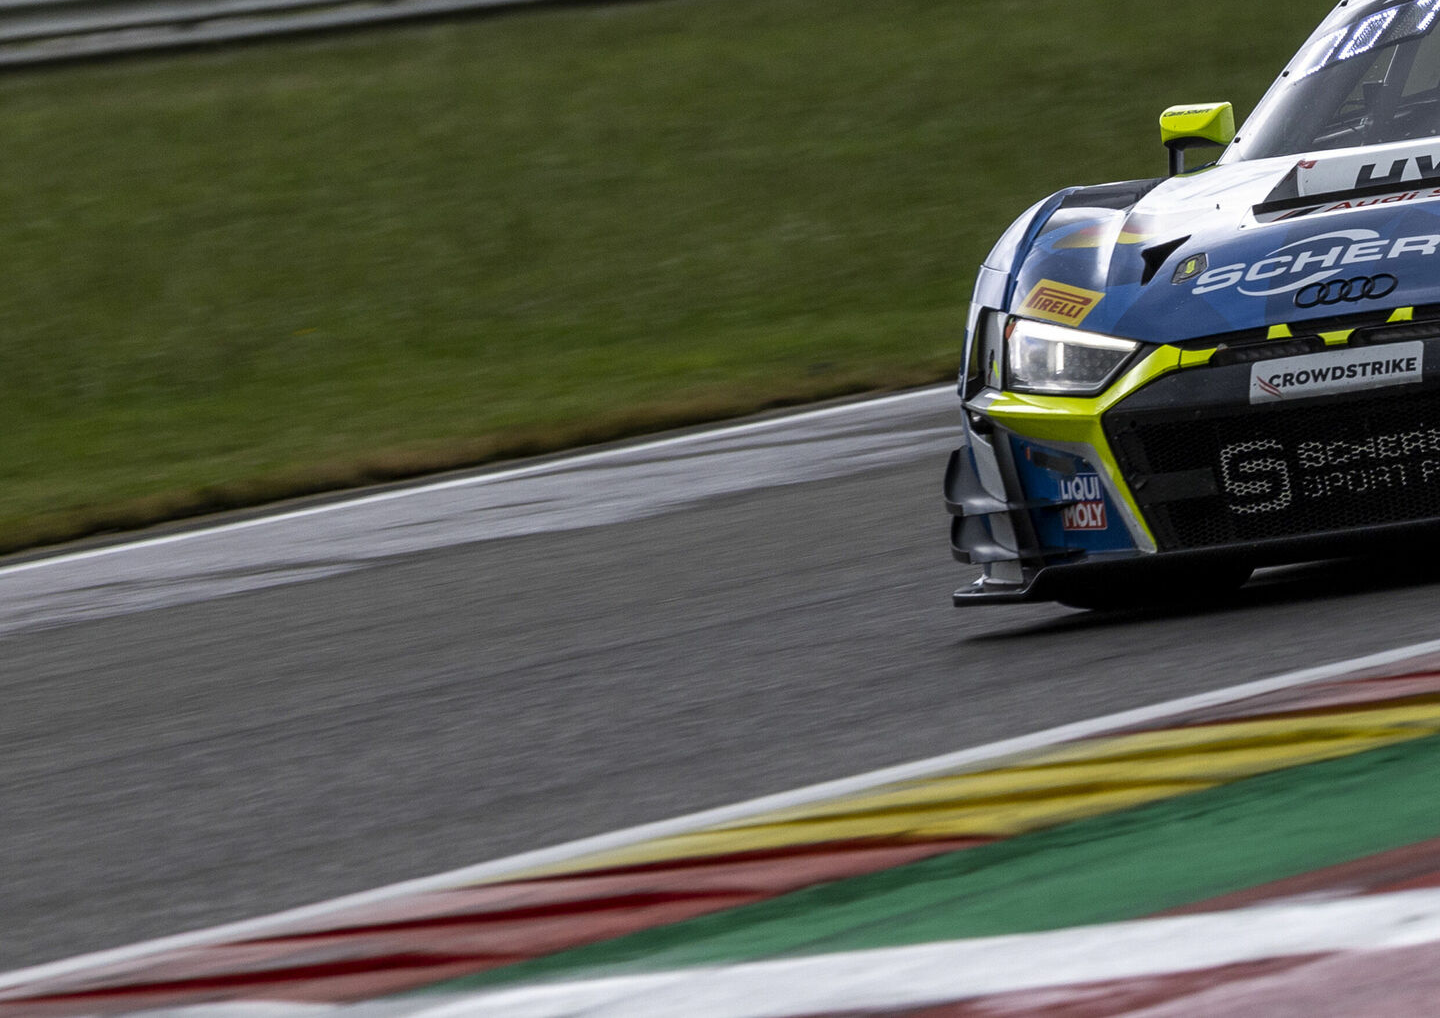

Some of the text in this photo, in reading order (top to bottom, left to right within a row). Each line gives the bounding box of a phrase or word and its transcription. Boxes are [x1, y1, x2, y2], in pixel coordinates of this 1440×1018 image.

[1325, 190, 1421, 212] Audi
[1025, 286, 1093, 319] PIRELLI
[1267, 356, 1417, 388] CROWDSTRIKE
[1060, 475, 1101, 501] LIQUI
[1064, 501, 1104, 528] MOLY
